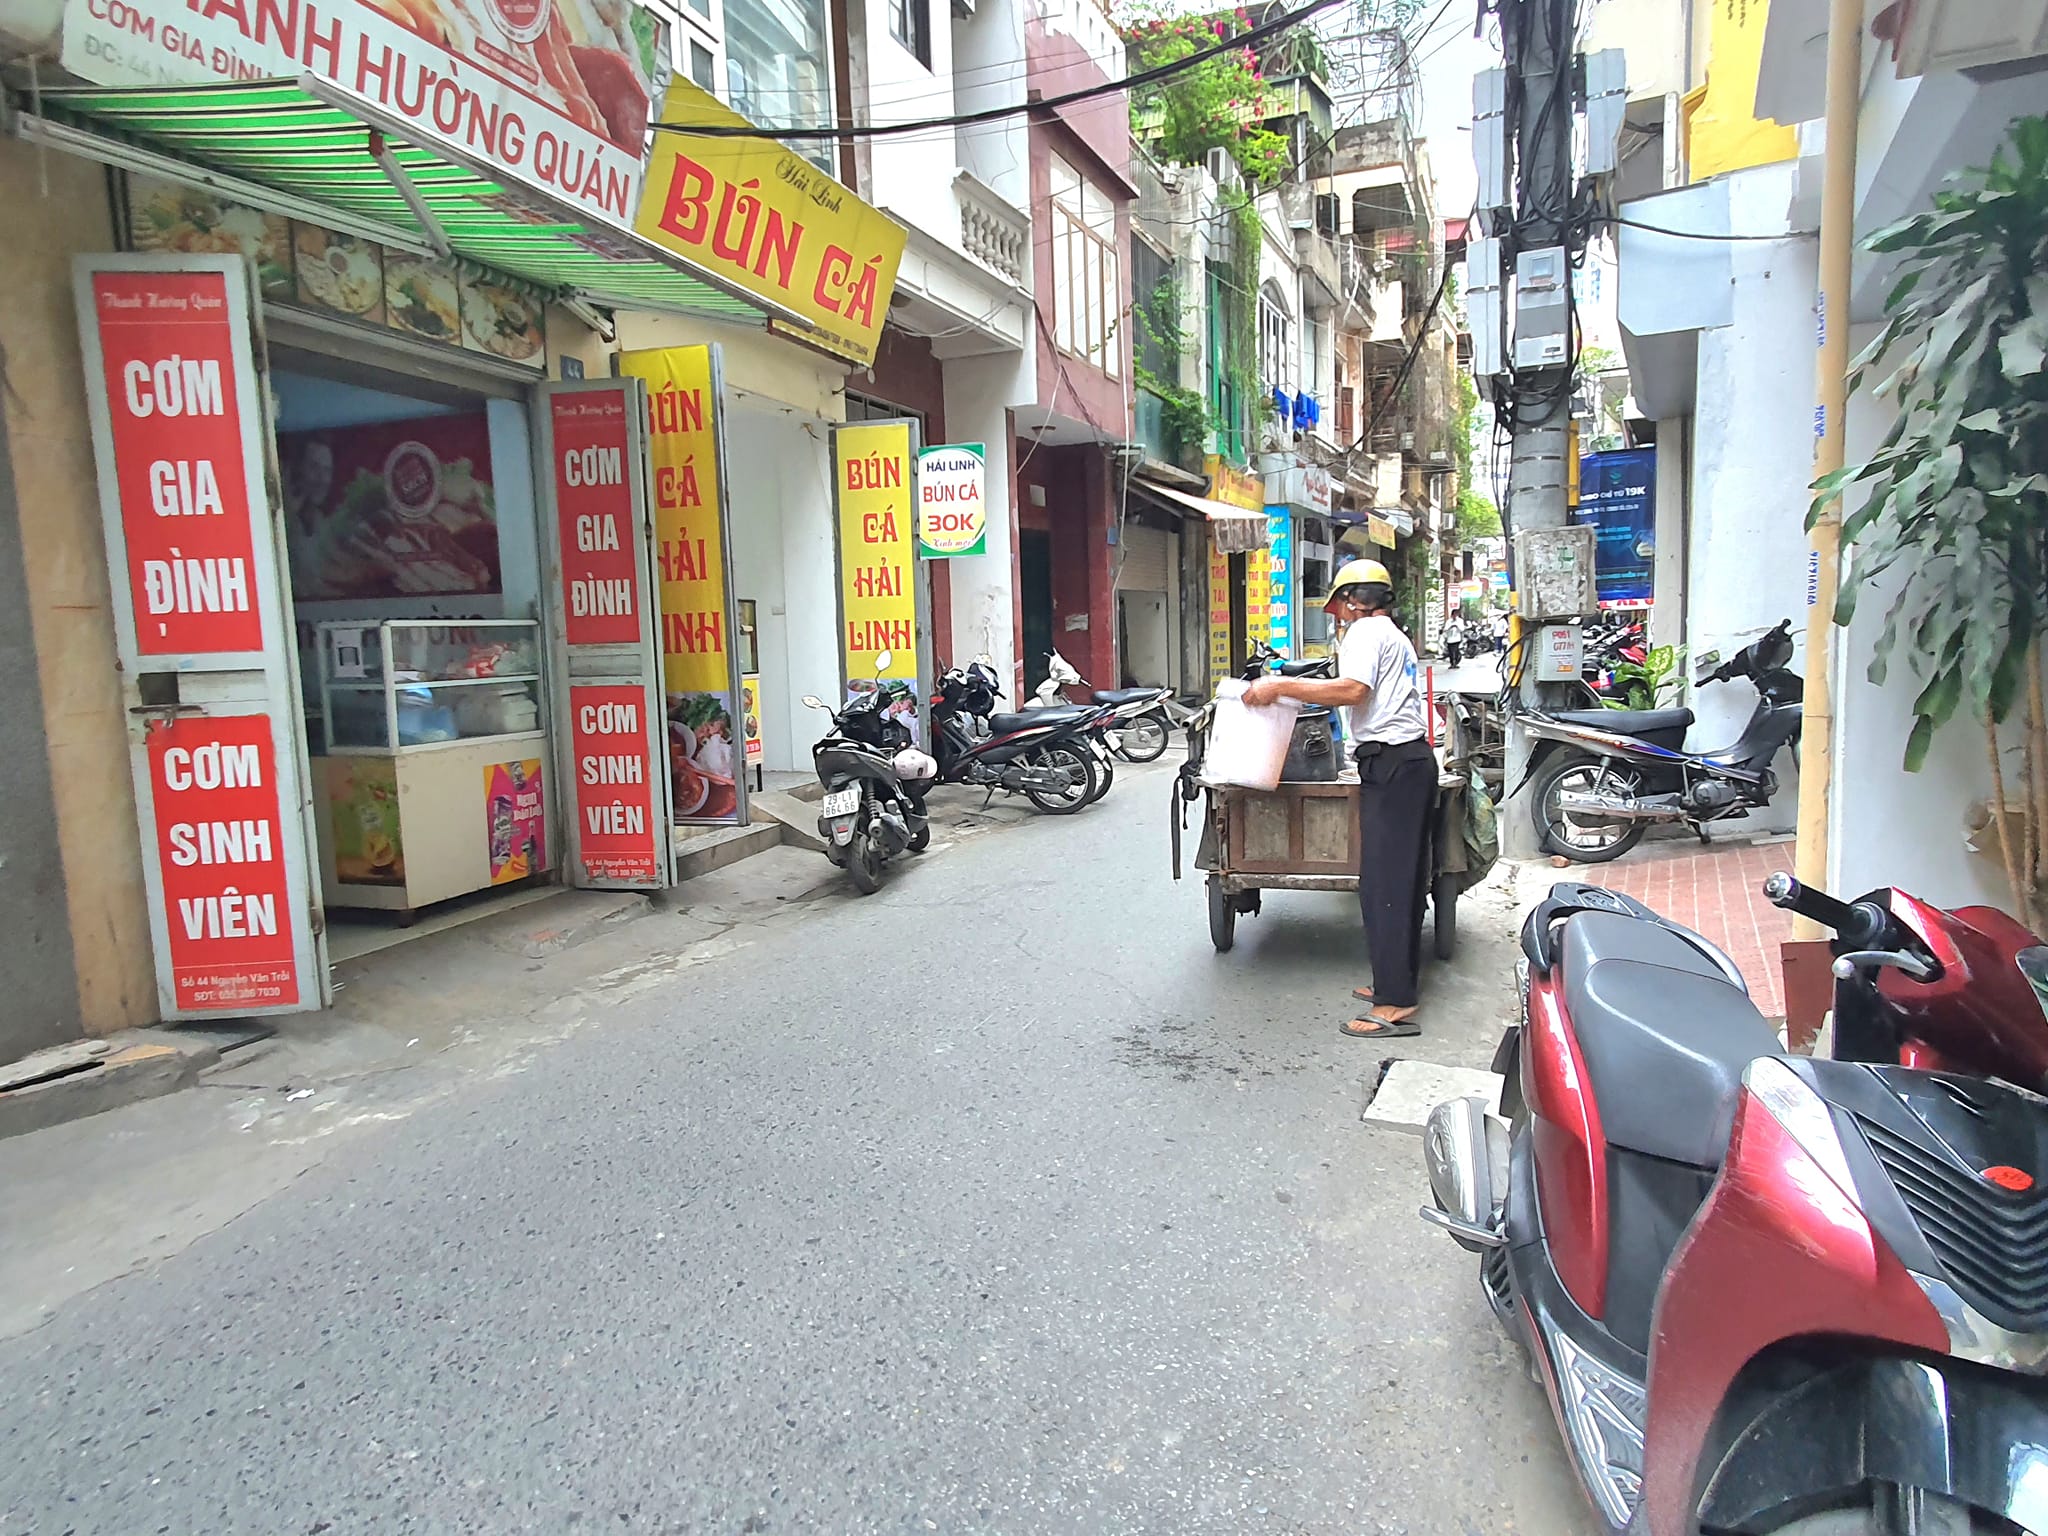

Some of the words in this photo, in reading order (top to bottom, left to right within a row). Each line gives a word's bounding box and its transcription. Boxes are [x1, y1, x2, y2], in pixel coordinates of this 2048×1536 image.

[162, 25, 205, 66] GIA
[212, 46, 272, 80] ĐÌN
[356, 32, 525, 165] HƯỜNG
[534, 130, 630, 219] QUÁN
[809, 178, 843, 214] Linh
[658, 151, 805, 290] BÚN
[813, 244, 883, 329] CÁ
[124, 355, 225, 419] CƠM
[564, 446, 623, 487] CƠM
[656, 454, 702, 509] CÁ
[847, 453, 901, 491] BÚN
[949, 460, 976, 471] LINH
[150, 458, 224, 517] GIA
[923, 481, 955, 503] BÚN
[958, 479, 979, 501] CÁ
[576, 514, 620, 553] GIA
[863, 505, 899, 544] CÁ
[928, 513, 975, 532] 30K
[144, 547, 249, 613] ĐÌNH
[570, 578, 632, 617] ĐÌNH
[854, 559, 902, 599] HẢI
[663, 611, 722, 655] INH
[849, 619, 912, 652] LINH
[580, 702, 638, 736] CƠM
[163, 739, 261, 792] CƠM
[582, 755, 642, 786] SINH
[586, 799, 644, 836] VIÊN
[170, 819, 274, 867] SINH
[178, 885, 278, 942] VIÊN
